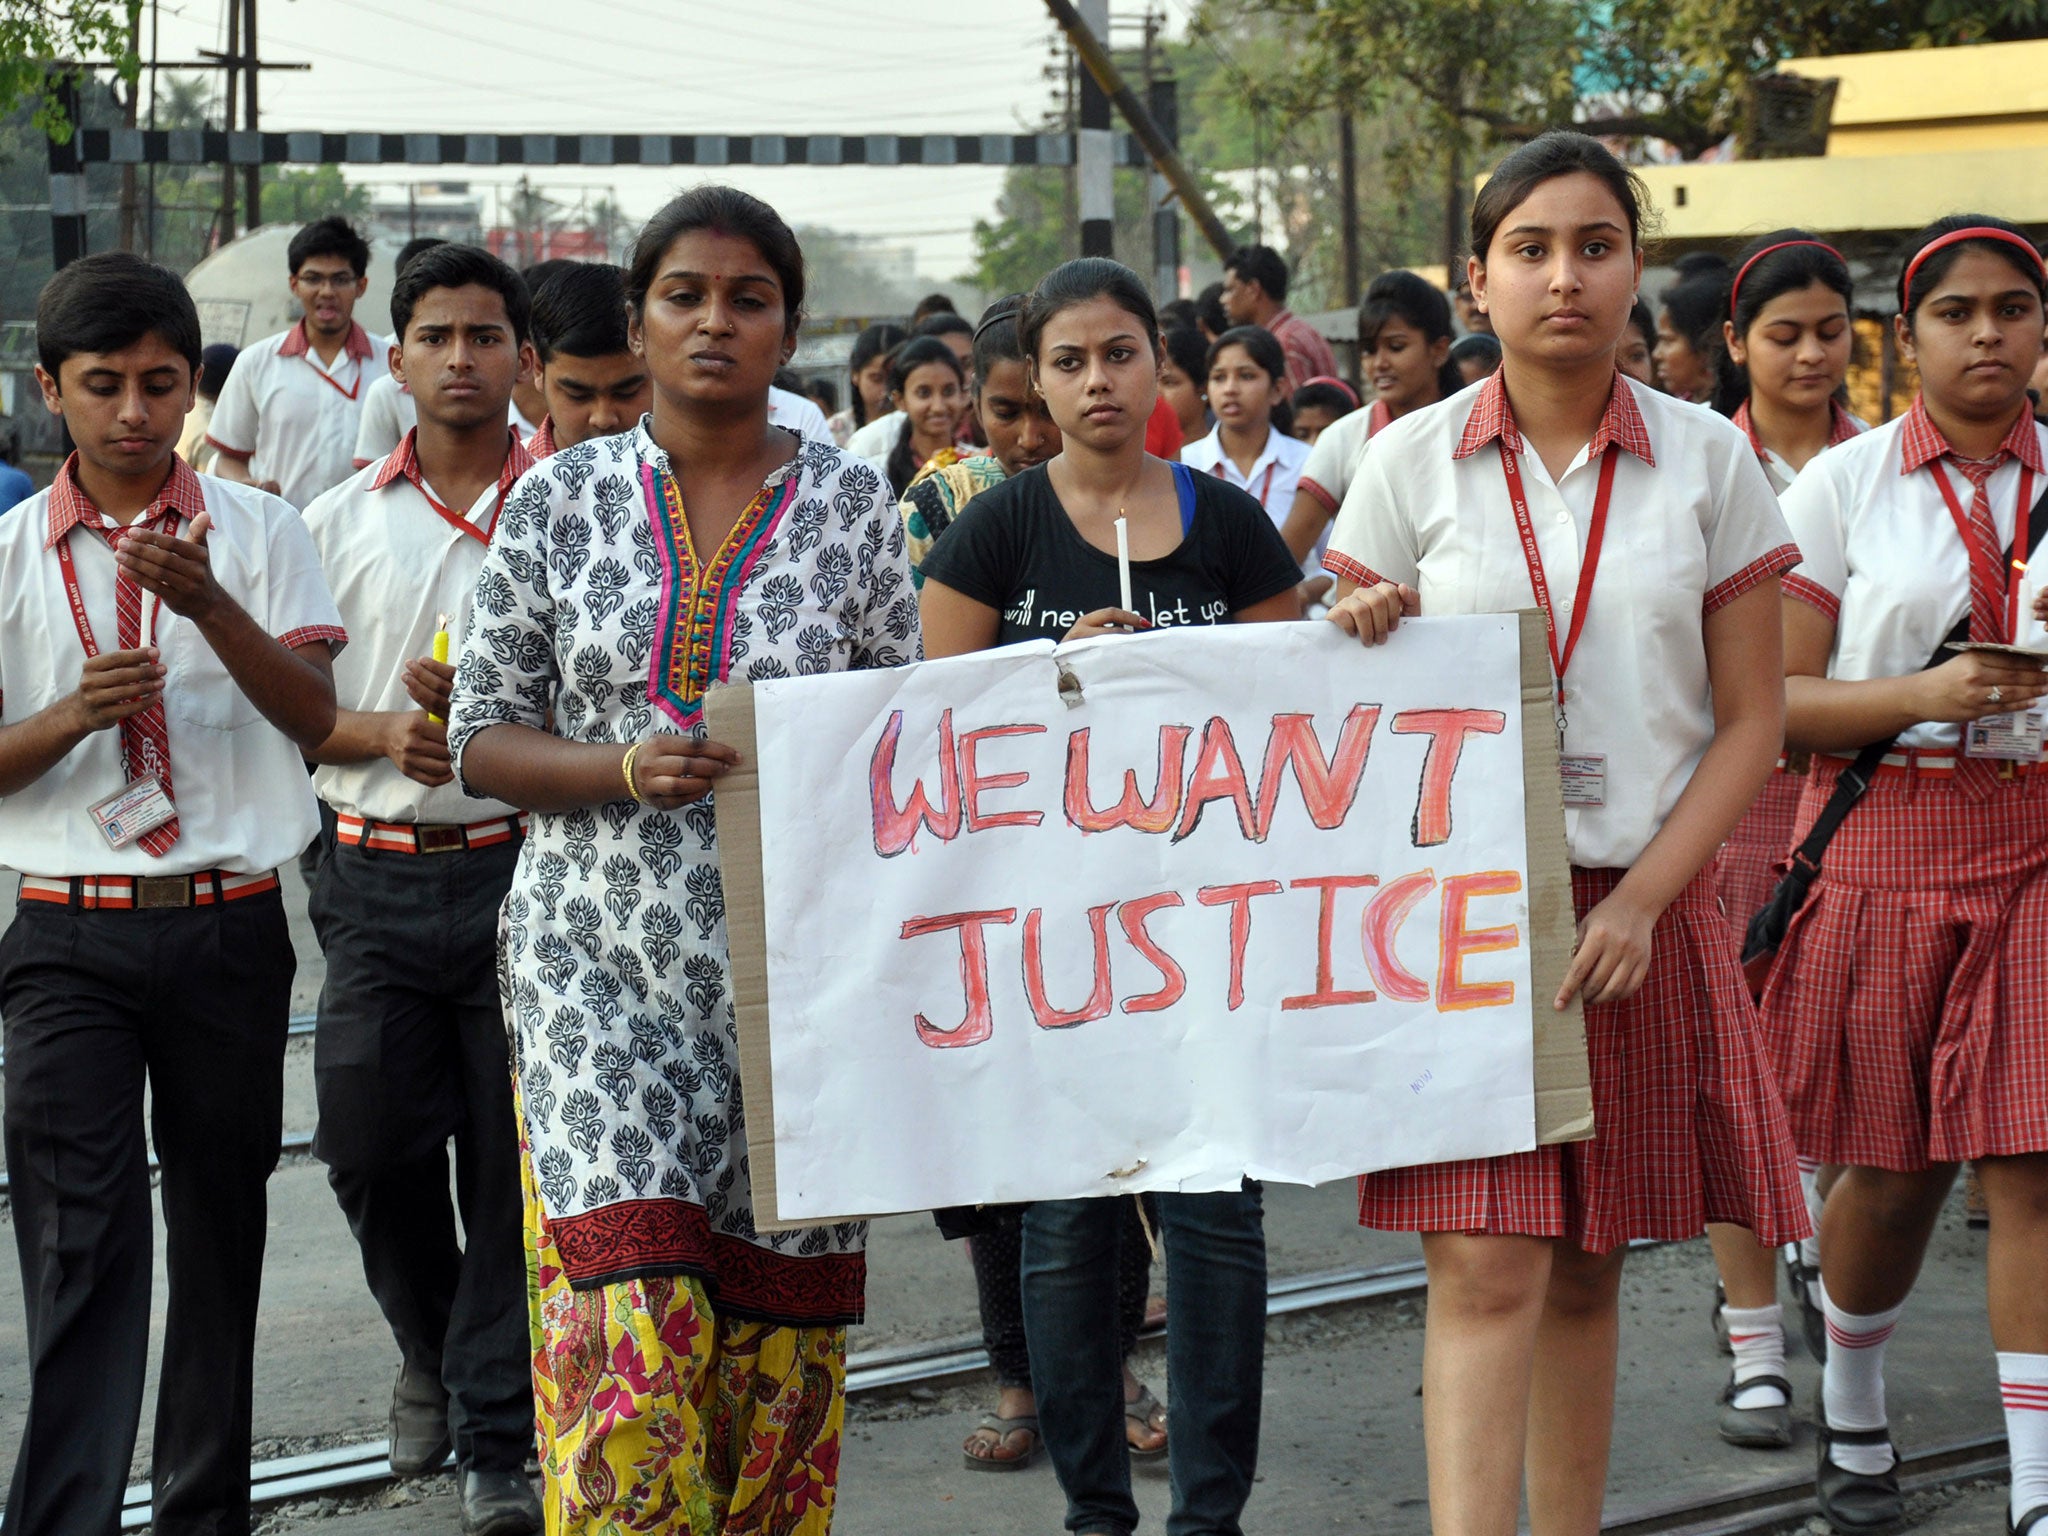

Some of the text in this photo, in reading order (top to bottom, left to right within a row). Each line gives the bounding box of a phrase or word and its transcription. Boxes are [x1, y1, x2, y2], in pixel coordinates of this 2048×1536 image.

[1515, 499, 1528, 527] MARY
[1525, 537, 1540, 567] JESUS
[1533, 568, 1543, 582] OF
[69, 582, 81, 606] MARY
[1149, 591, 1191, 628] let
[79, 615, 92, 642] JESUS
[869, 703, 1505, 858] WE WANT
[900, 868, 1521, 1048] JUSTICE
